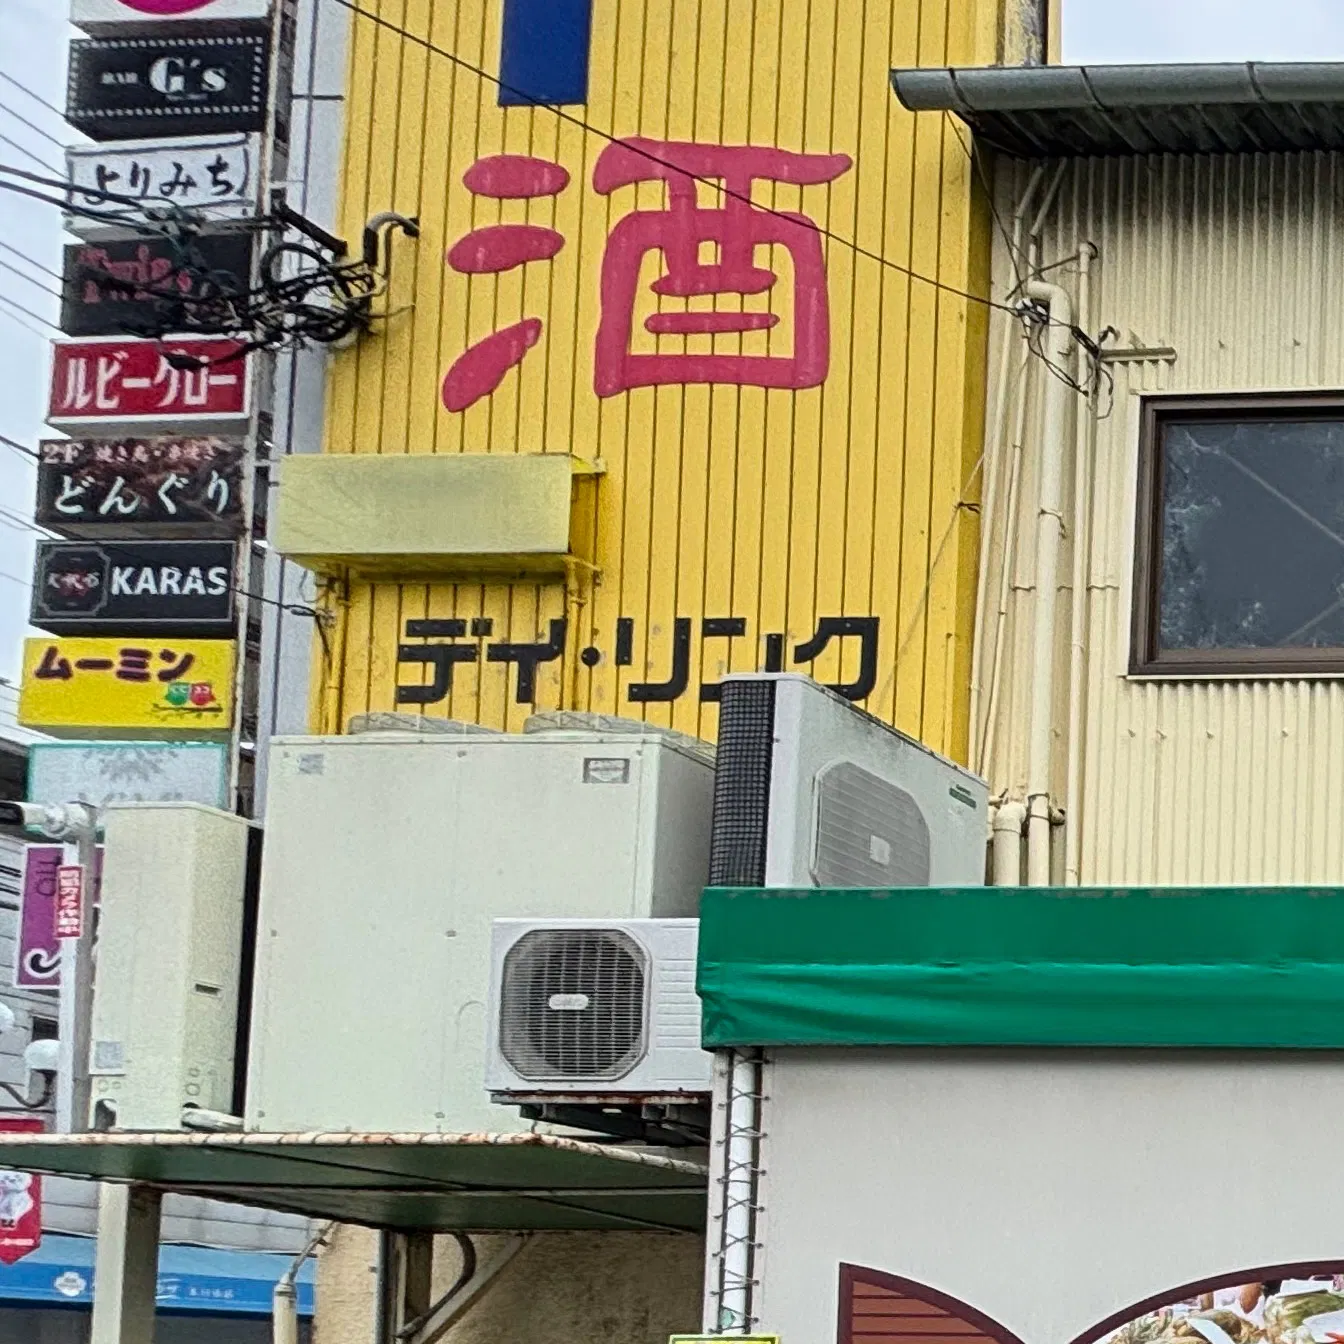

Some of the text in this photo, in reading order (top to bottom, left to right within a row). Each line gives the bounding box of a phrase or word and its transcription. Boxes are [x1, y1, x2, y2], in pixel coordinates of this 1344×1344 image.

[149, 56, 227, 93] G's
[85, 153, 235, 206] よりみち
[441, 136, 853, 412] 酒
[55, 470, 229, 516] どんぐり
[111, 566, 229, 596] KARAS
[34, 645, 196, 683] ムーミン
